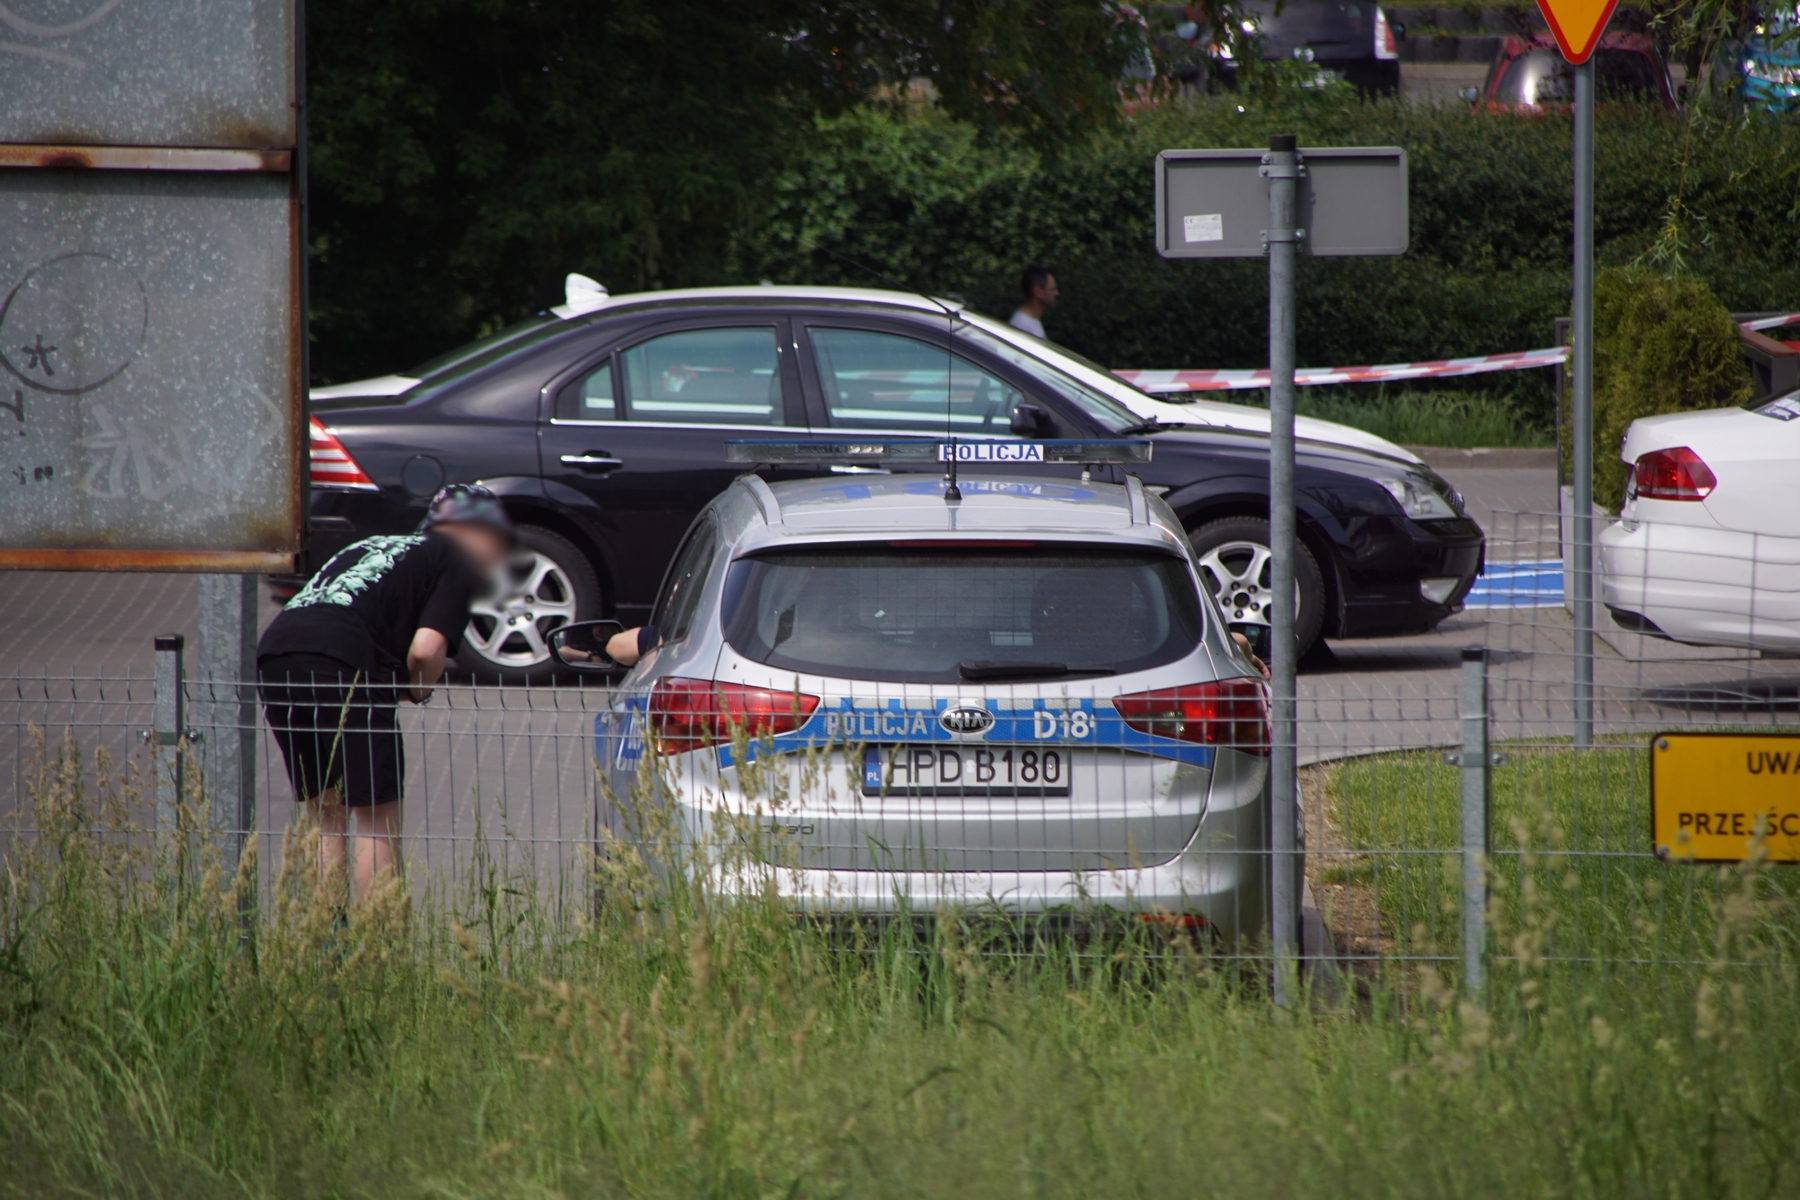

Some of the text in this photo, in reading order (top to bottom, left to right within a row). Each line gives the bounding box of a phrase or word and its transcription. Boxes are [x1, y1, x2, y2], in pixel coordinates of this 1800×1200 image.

[943, 445, 1040, 460] POLICJA
[827, 711, 927, 736] POLICJA
[950, 711, 986, 728] KIA
[887, 751, 1060, 783] HPD B180
[867, 771, 880, 781] PL
